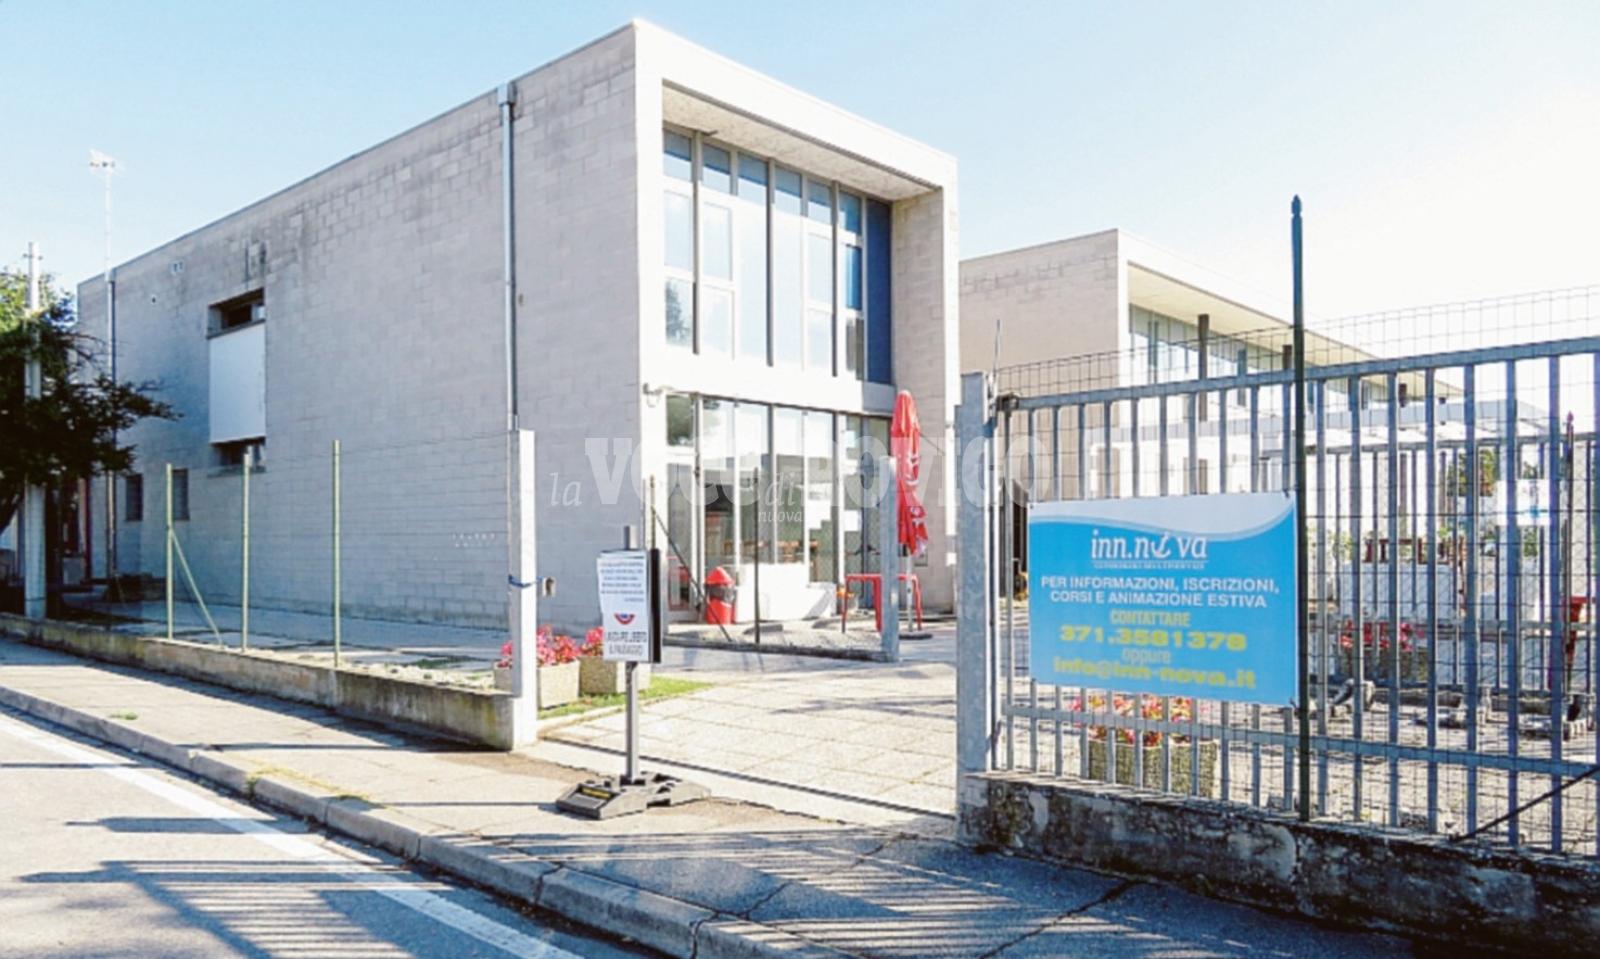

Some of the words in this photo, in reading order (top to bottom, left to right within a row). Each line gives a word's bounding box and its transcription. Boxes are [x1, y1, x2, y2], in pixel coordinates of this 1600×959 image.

[1041, 576, 1068, 588] PER
[1070, 576, 1178, 592] INFORMAZIONI,
[1183, 578, 1280, 594] ISCRIZIONI,
[1050, 591, 1092, 603] CORSI
[1095, 592, 1105, 604] E
[1107, 591, 1204, 607] ANIMAZIONE
[1207, 594, 1267, 608] ESTIVA
[1110, 609, 1191, 626] CONTATTARE
[1122, 648, 1171, 665] oppure
[1053, 657, 1257, 688] info@inn-nova.it
